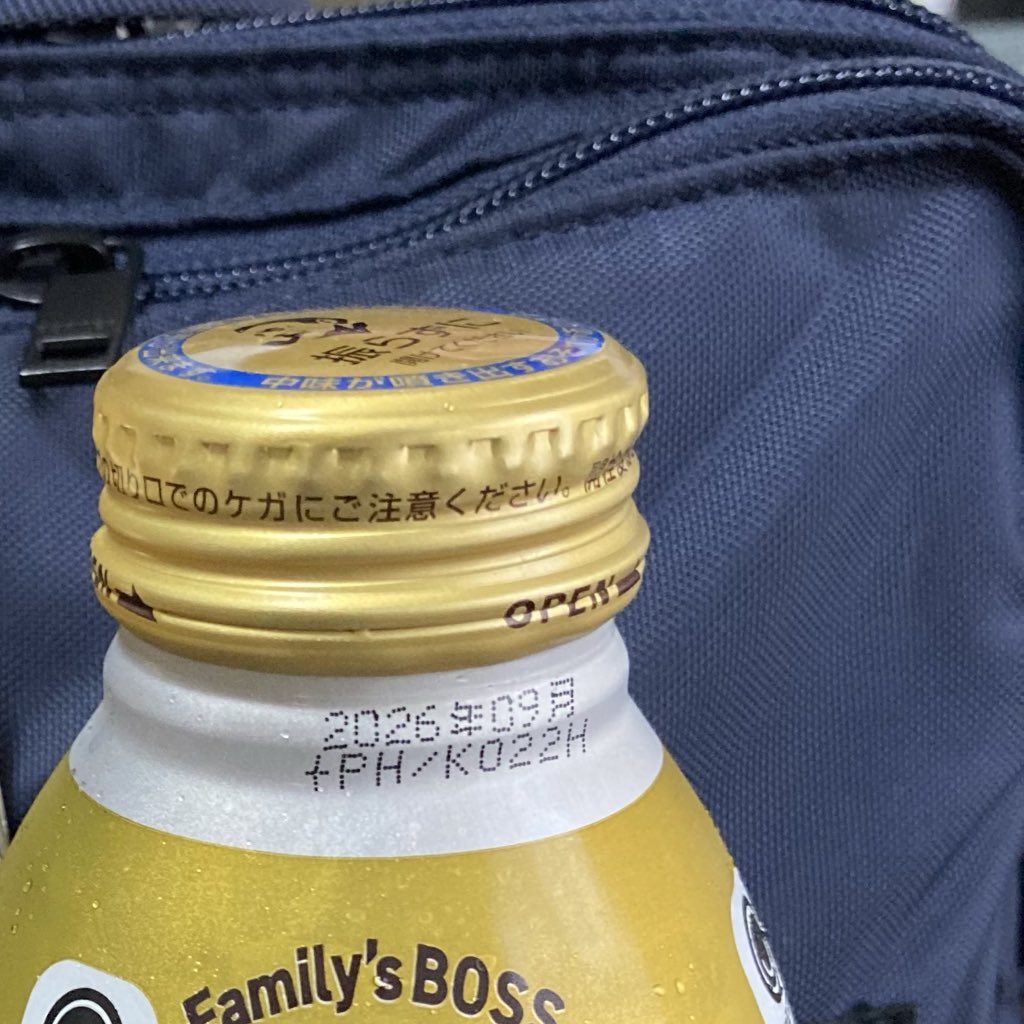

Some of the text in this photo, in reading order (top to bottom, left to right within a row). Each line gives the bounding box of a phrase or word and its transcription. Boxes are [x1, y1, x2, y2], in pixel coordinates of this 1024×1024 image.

[311, 317, 501, 366] 振らずに
[503, 575, 616, 629] OPEN
[324, 677, 574, 751] 2026年09月
